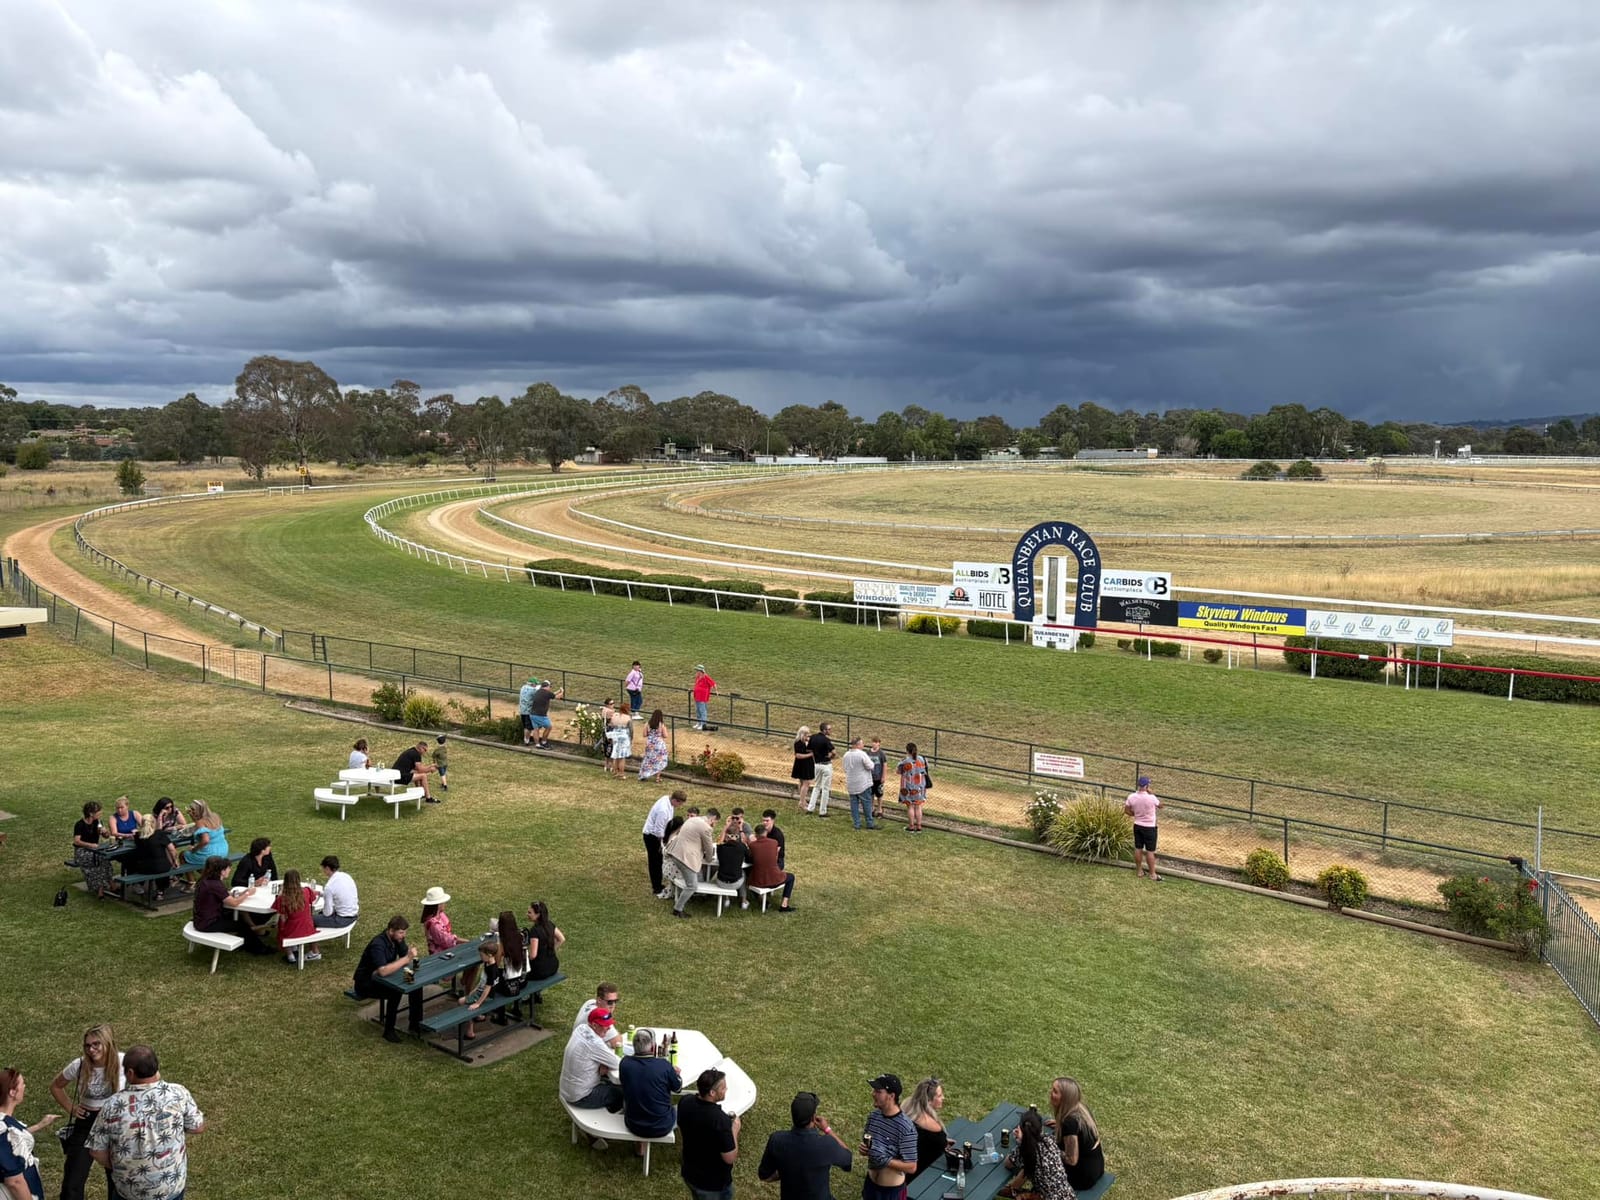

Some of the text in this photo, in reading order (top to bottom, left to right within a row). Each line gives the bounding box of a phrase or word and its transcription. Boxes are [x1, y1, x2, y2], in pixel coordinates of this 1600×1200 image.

[955, 569, 989, 578] ALLBIDS
[1017, 526, 1096, 612] QUEANBEYAN RACE CLUB
[1103, 577, 1143, 587] CARBIDS
[855, 594, 898, 603] WINDOWS
[979, 591, 1007, 609] HOTEL
[1196, 605, 1288, 624] Skyview Windows
[1203, 620, 1278, 632] Quality Windows Fast
